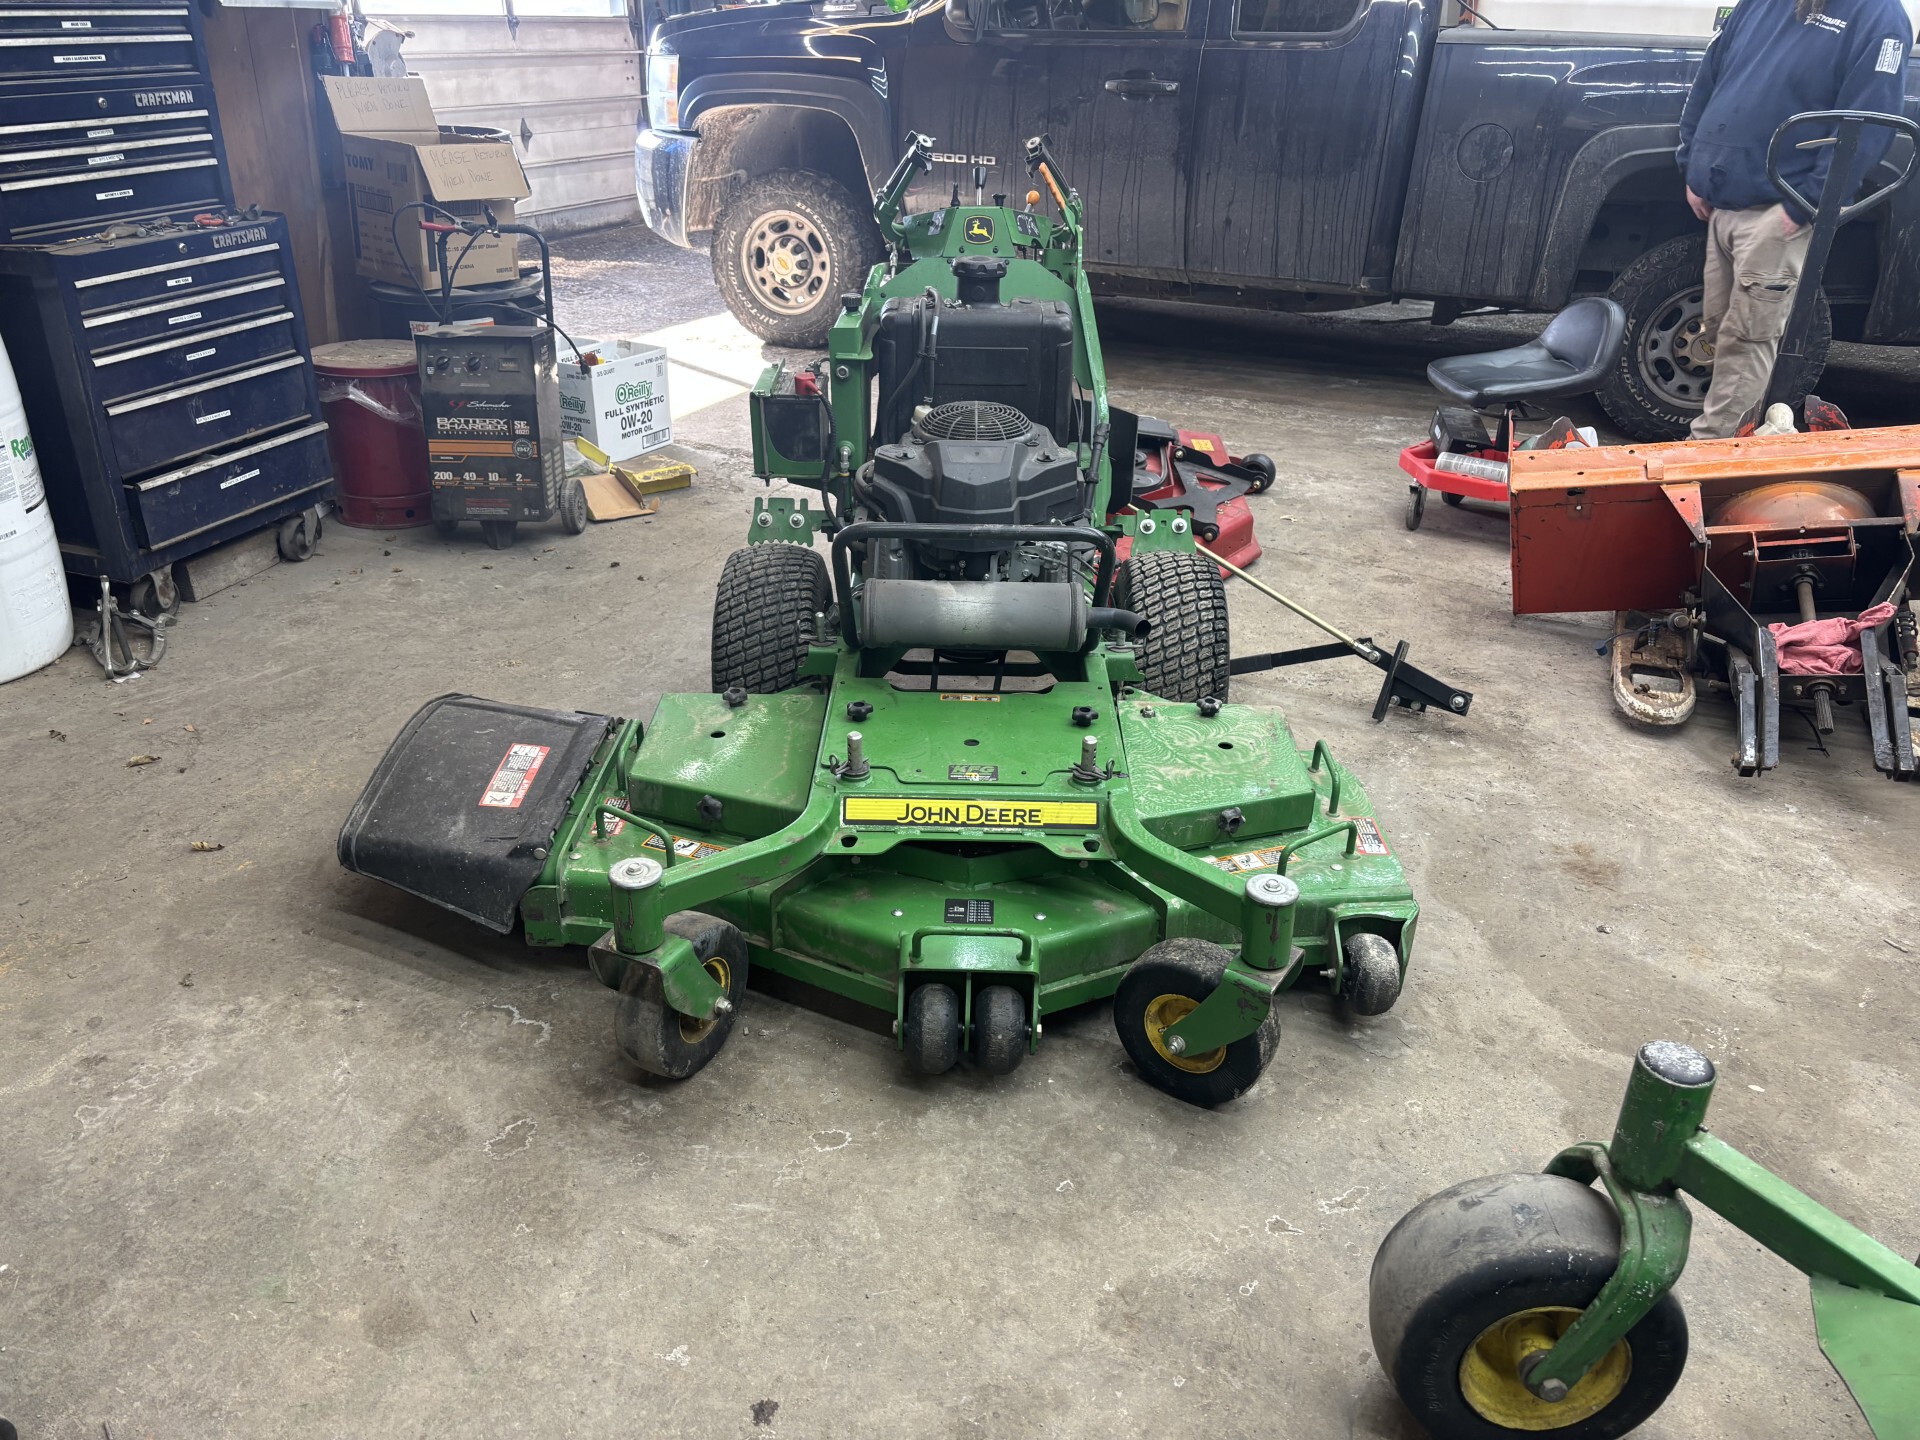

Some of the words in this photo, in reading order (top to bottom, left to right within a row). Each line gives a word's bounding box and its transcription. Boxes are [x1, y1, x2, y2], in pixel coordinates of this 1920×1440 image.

[135, 90, 194, 107] CRAFTSMAN
[335, 81, 374, 101] PLEASE
[352, 100, 377, 115] WHEN
[383, 98, 409, 111] DONE
[345, 153, 375, 171] TOMY
[430, 149, 470, 168] PLEASE
[473, 148, 508, 161] RETURN
[931, 153, 967, 164] 500
[971, 155, 996, 165] HD
[439, 172, 465, 190] WHEN
[467, 169, 494, 183] DONE
[212, 227, 267, 248] CRAFTSMAN
[615, 381, 653, 405] O'Reilly
[604, 408, 624, 420] FULL
[626, 395, 665, 413] SYNTHETIC
[564, 415, 591, 424] SYNTHETIC
[620, 409, 653, 430] 0W-20
[622, 429, 643, 440] MOTOR
[434, 471, 453, 480] 200
[463, 472, 476, 480] 40
[488, 472, 499, 482] 10
[516, 473, 522, 482] 2
[896, 803, 959, 822] JOHN
[966, 804, 1042, 823] DEERE
